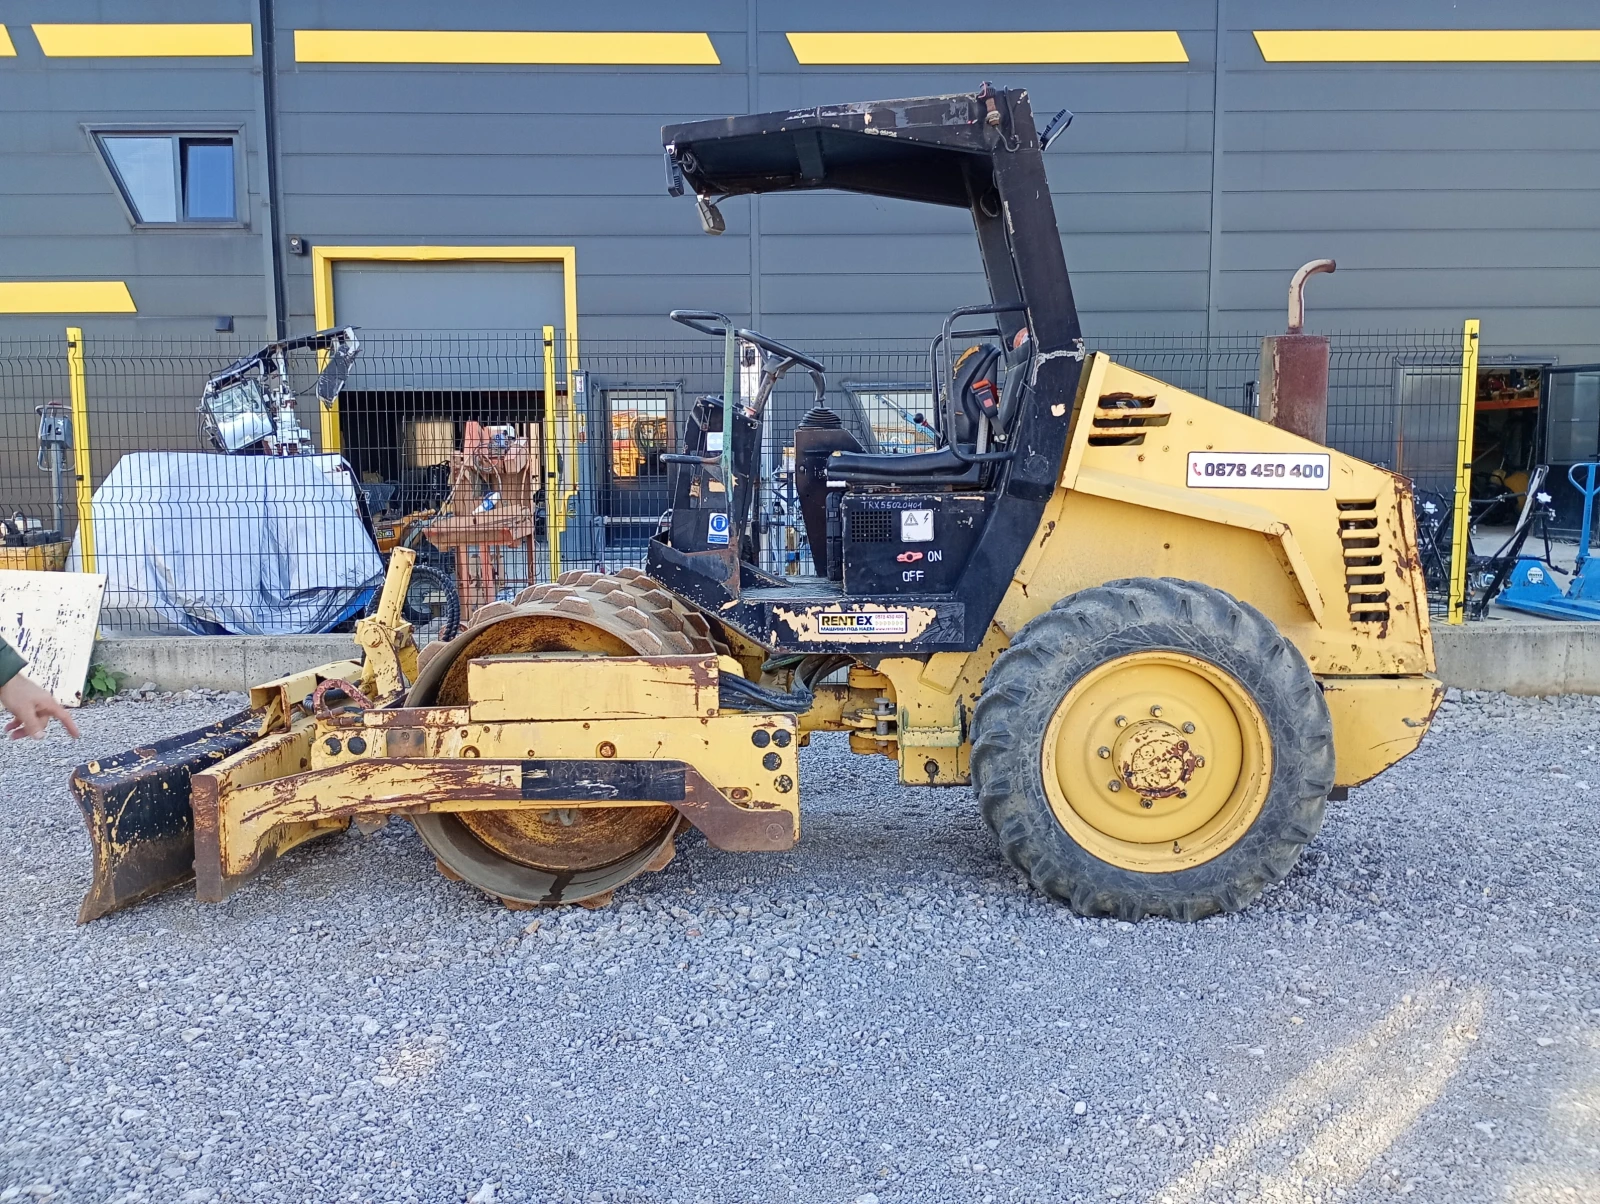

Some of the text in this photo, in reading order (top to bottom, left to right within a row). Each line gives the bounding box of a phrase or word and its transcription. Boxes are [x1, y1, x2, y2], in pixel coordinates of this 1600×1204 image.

[1204, 462, 1324, 478] 0878 450 400
[927, 550, 942, 562] ON
[902, 570, 925, 582] OFF
[821, 616, 873, 626] RENTEX
